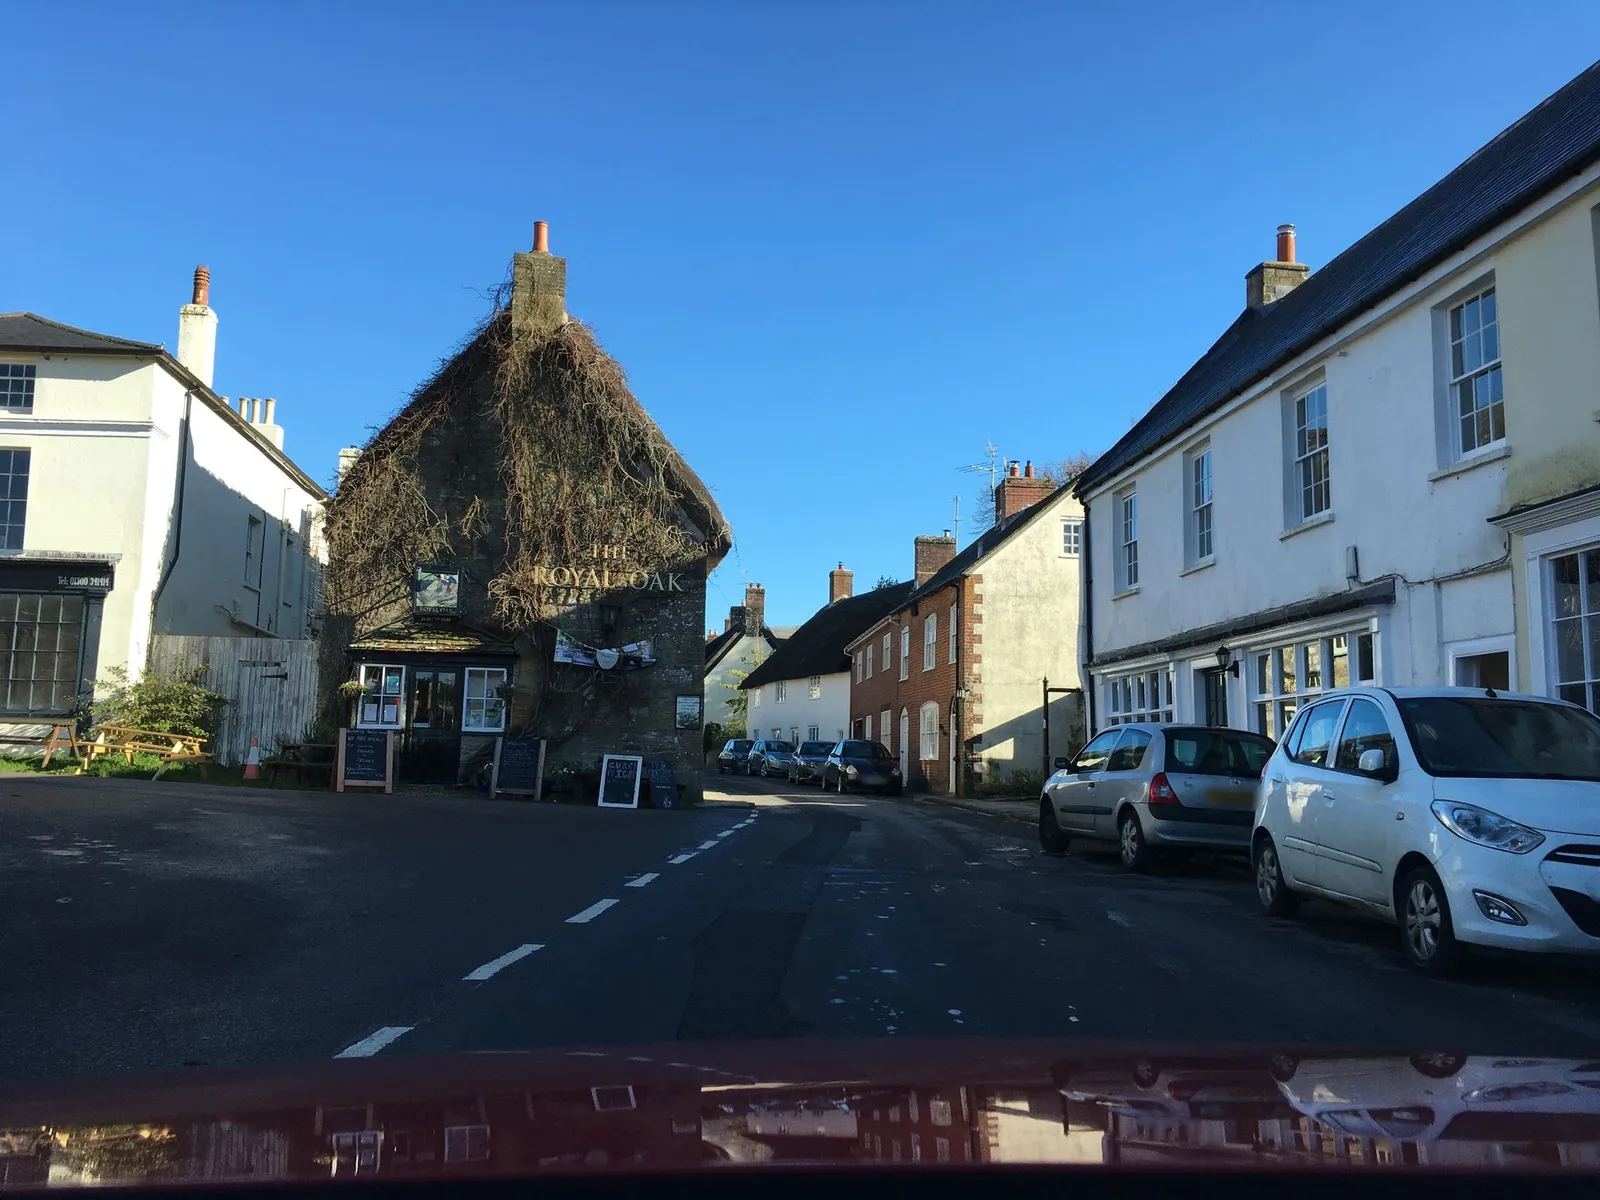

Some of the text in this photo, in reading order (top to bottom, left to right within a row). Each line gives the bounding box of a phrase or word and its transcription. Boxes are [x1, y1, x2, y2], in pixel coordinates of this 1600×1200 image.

[58, 576, 68, 585] Tel:
[533, 565, 685, 592] ROYAL OAK
